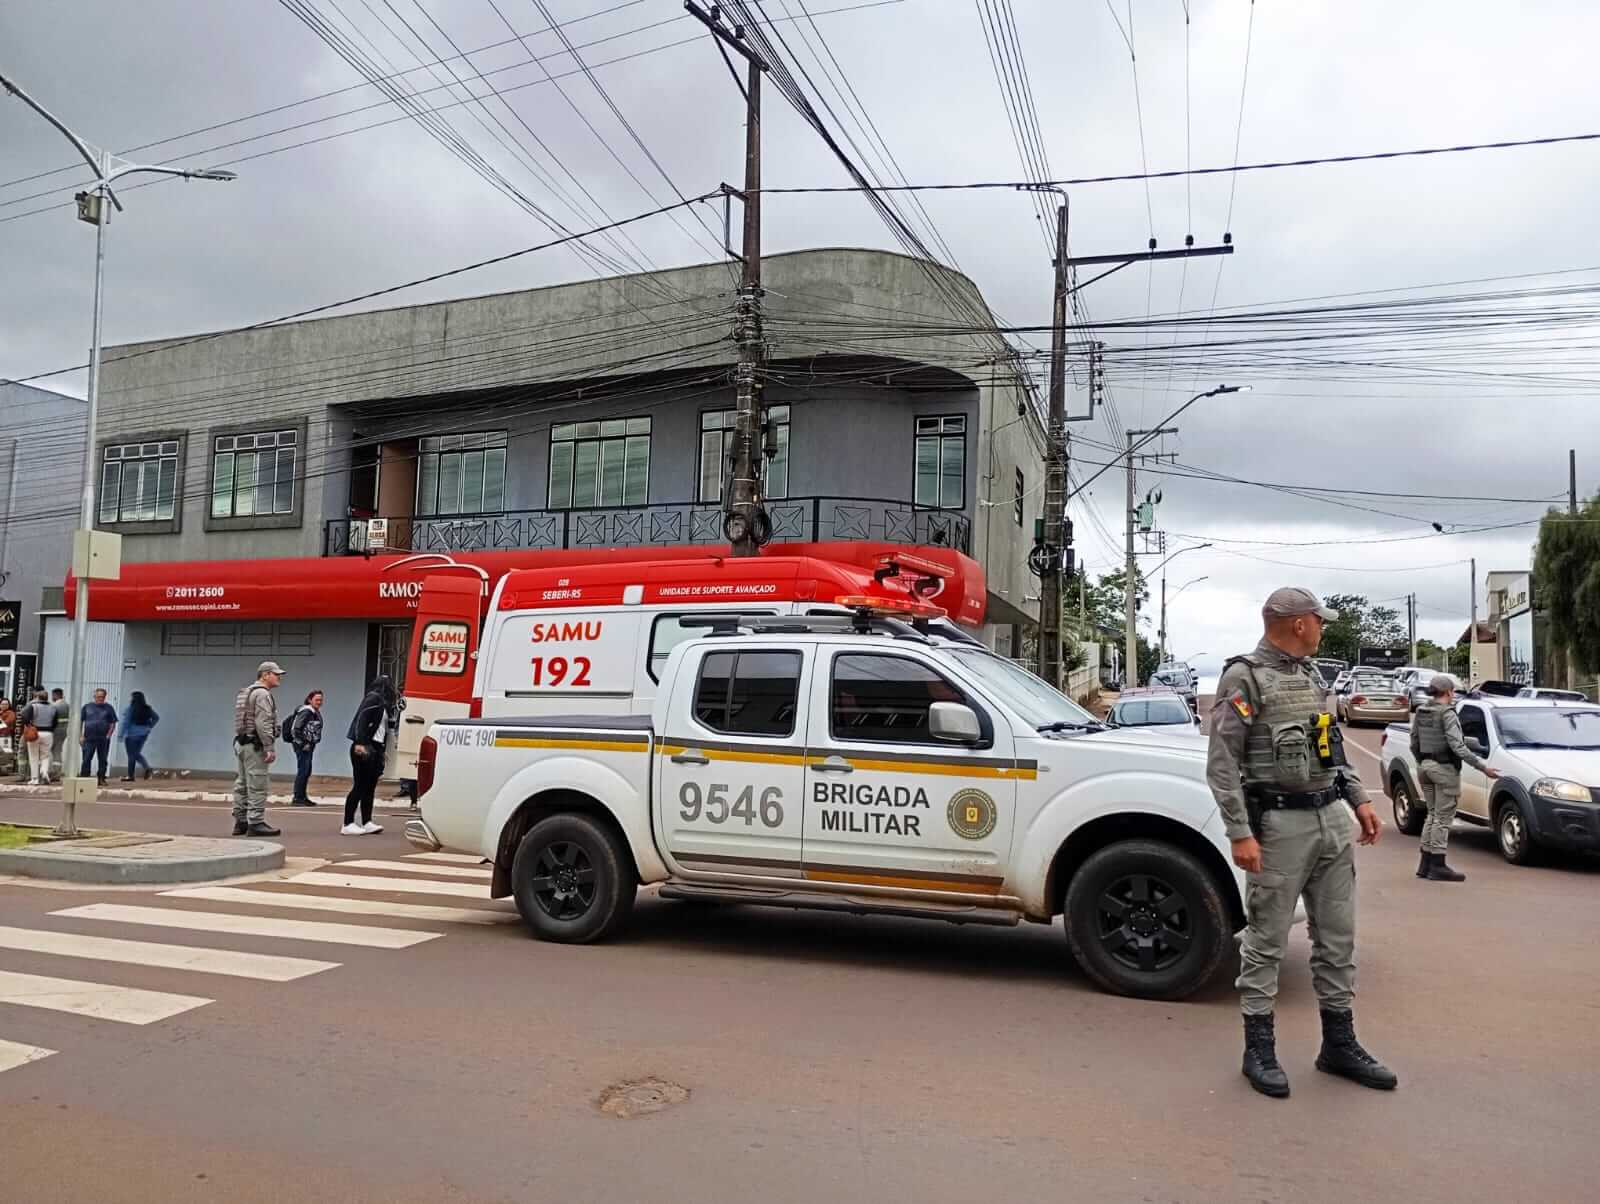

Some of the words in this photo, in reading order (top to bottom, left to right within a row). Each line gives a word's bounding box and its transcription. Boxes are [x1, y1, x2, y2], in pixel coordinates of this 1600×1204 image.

[174, 587, 197, 598] 2011
[199, 586, 225, 598] 2600
[542, 589, 583, 600] SEBERI-RS
[659, 586, 691, 596] UNIDADE
[691, 586, 702, 595] DE
[702, 585, 734, 595] SUPORTE
[734, 584, 777, 595] AVANÇADO
[428, 631, 467, 644] SAMU
[531, 621, 603, 643] SAMU
[427, 650, 461, 668] 192
[531, 656, 592, 687] 192
[439, 728, 473, 746] FONE
[475, 729, 496, 747] 190
[678, 781, 785, 828] 9546
[812, 782, 931, 809] BRIGADA
[821, 810, 922, 837] MILITAR
